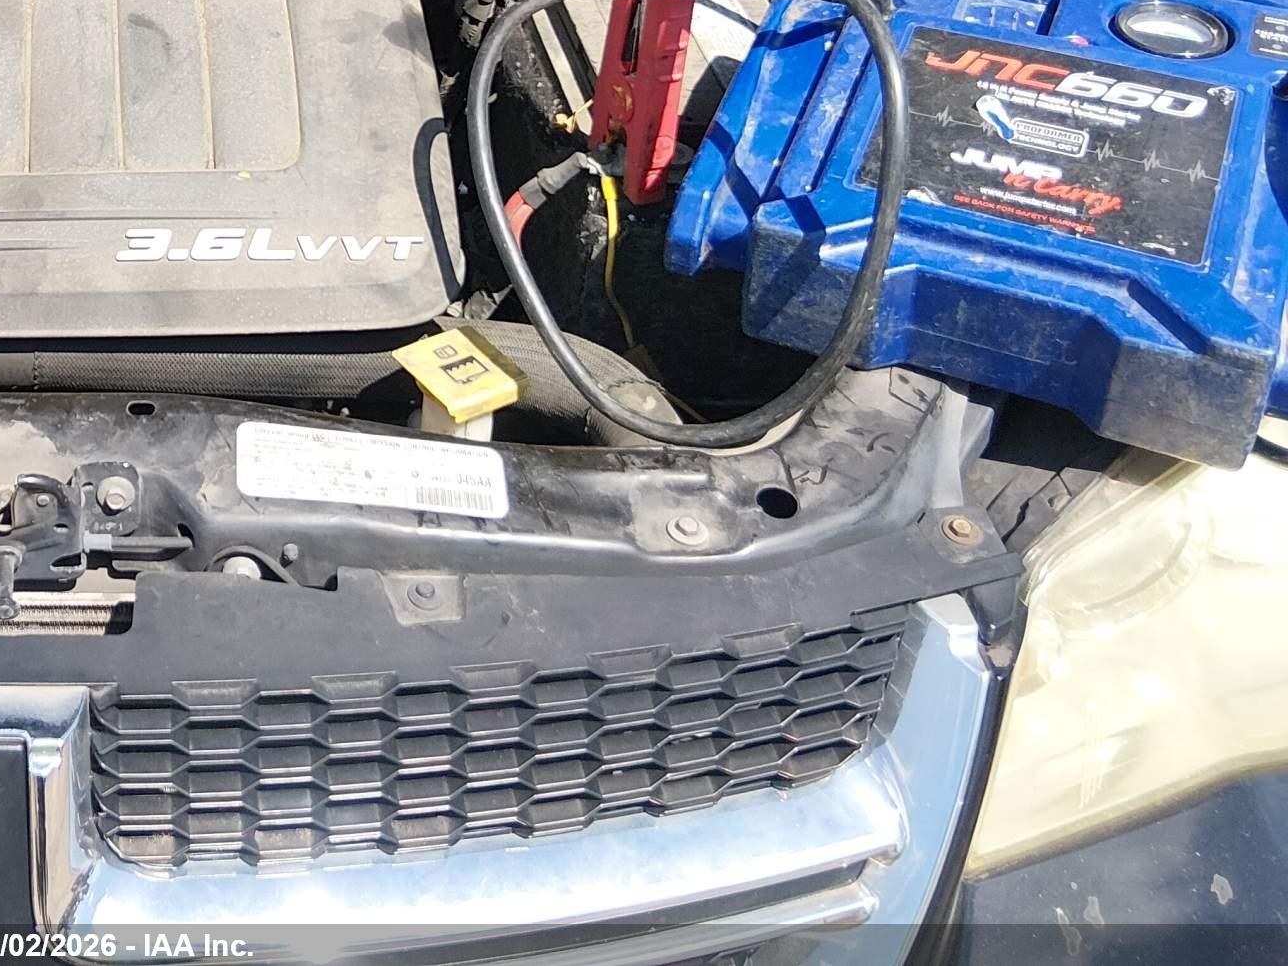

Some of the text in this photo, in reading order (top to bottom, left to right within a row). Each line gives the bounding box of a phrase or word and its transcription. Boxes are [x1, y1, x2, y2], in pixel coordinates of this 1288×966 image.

[924, 50, 1208, 118] JNC660
[116, 227, 425, 262] 3.6L VVT
